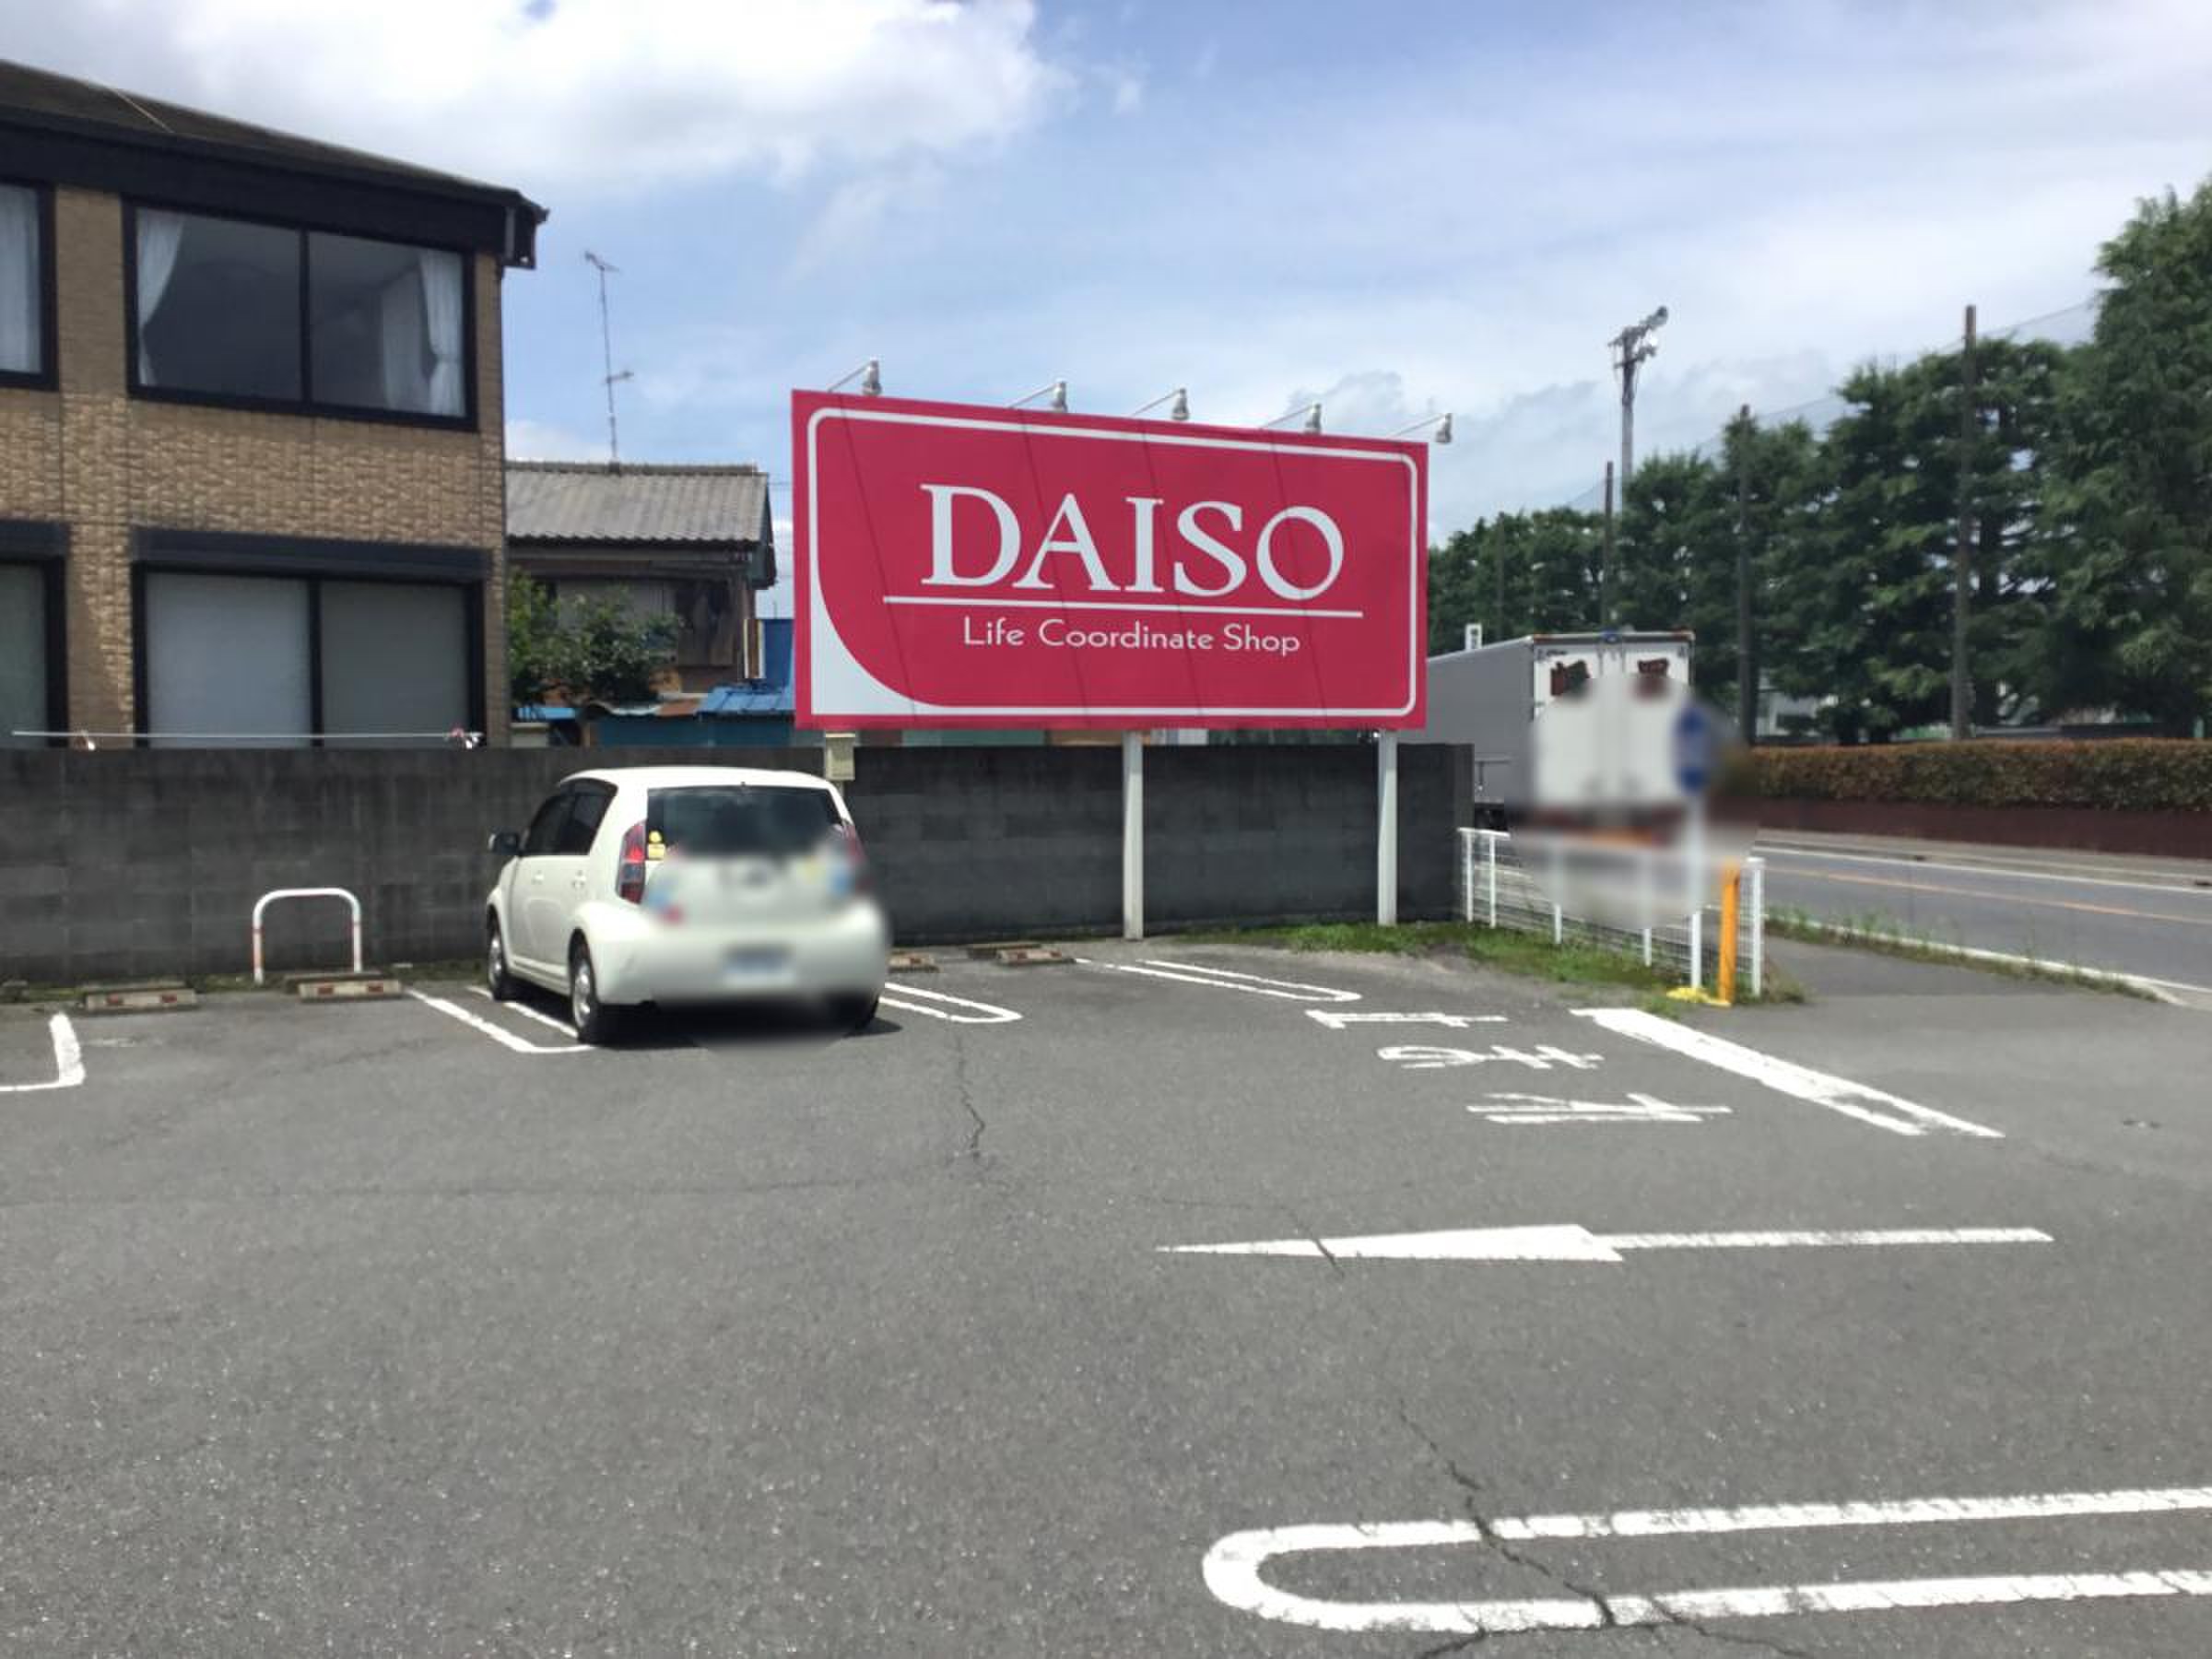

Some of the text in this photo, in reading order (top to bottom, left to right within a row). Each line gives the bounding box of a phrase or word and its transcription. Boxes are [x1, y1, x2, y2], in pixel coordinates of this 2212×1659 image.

[920, 483, 1345, 601] DAISO
[964, 616, 1300, 656] Life Coordinate Shop
[1305, 1008, 1733, 1124] 止まれ
